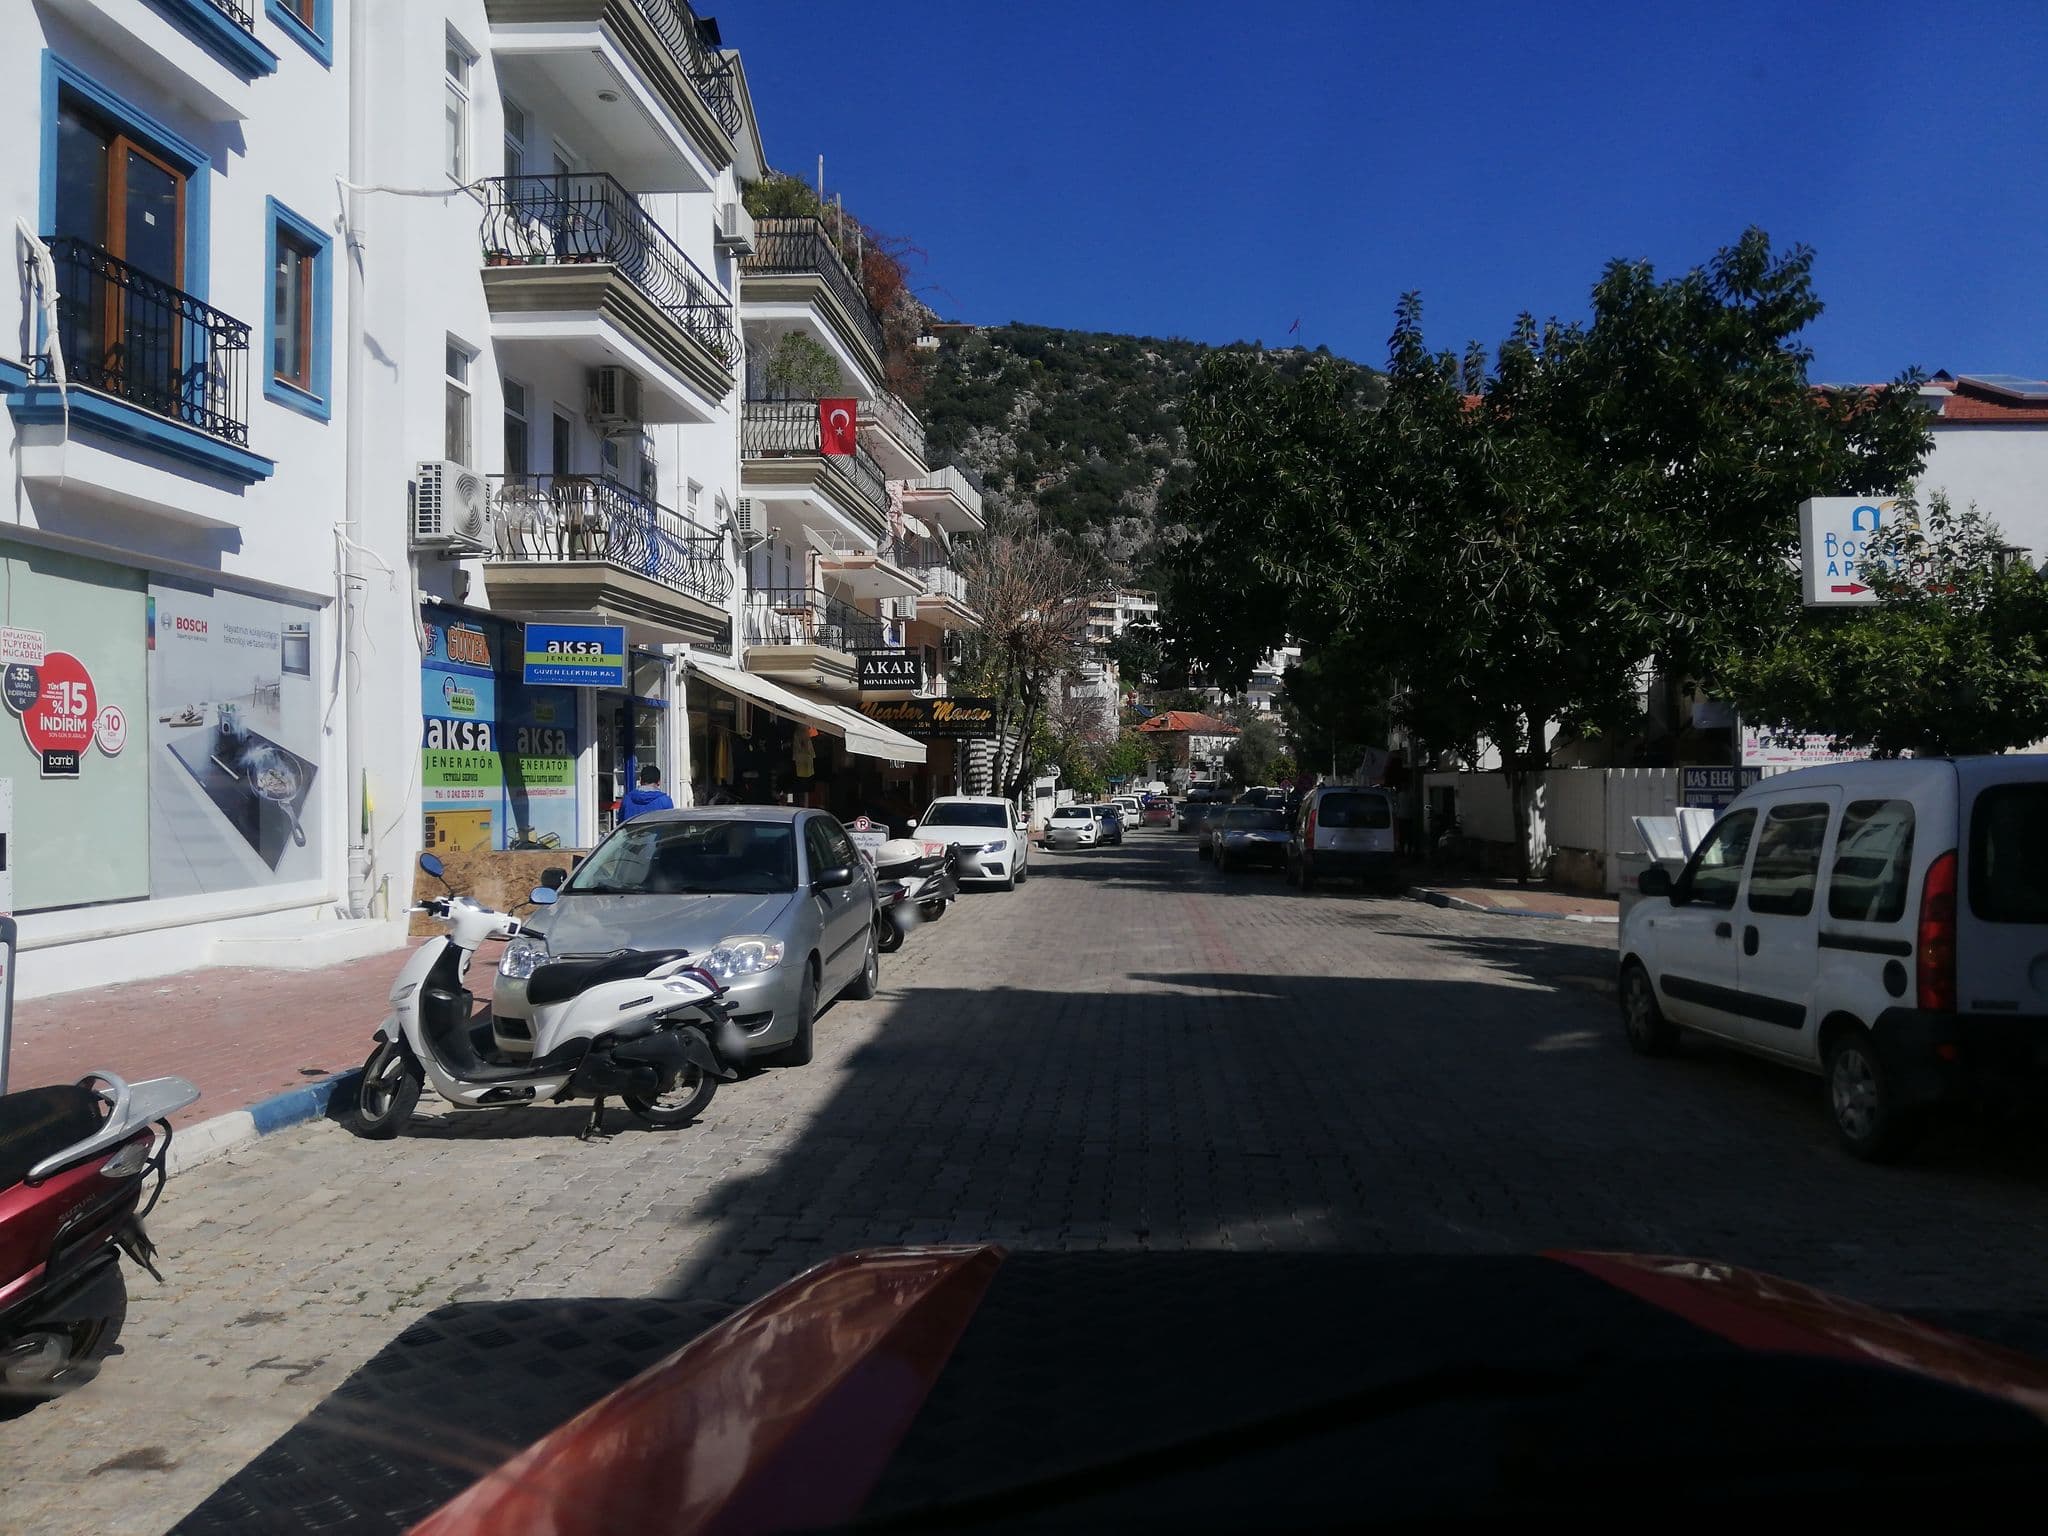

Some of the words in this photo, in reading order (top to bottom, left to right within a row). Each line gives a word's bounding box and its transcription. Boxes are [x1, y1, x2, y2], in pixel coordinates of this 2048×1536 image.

[176, 617, 208, 633] BOSCH
[547, 640, 602, 655] aksa
[863, 661, 916, 674] AKAR
[40, 713, 87, 732] İNDİRİM
[427, 719, 491, 752] aksa
[517, 727, 566, 755] aksa
[49, 755, 74, 766] bambi
[425, 756, 493, 770] JENERATÖR
